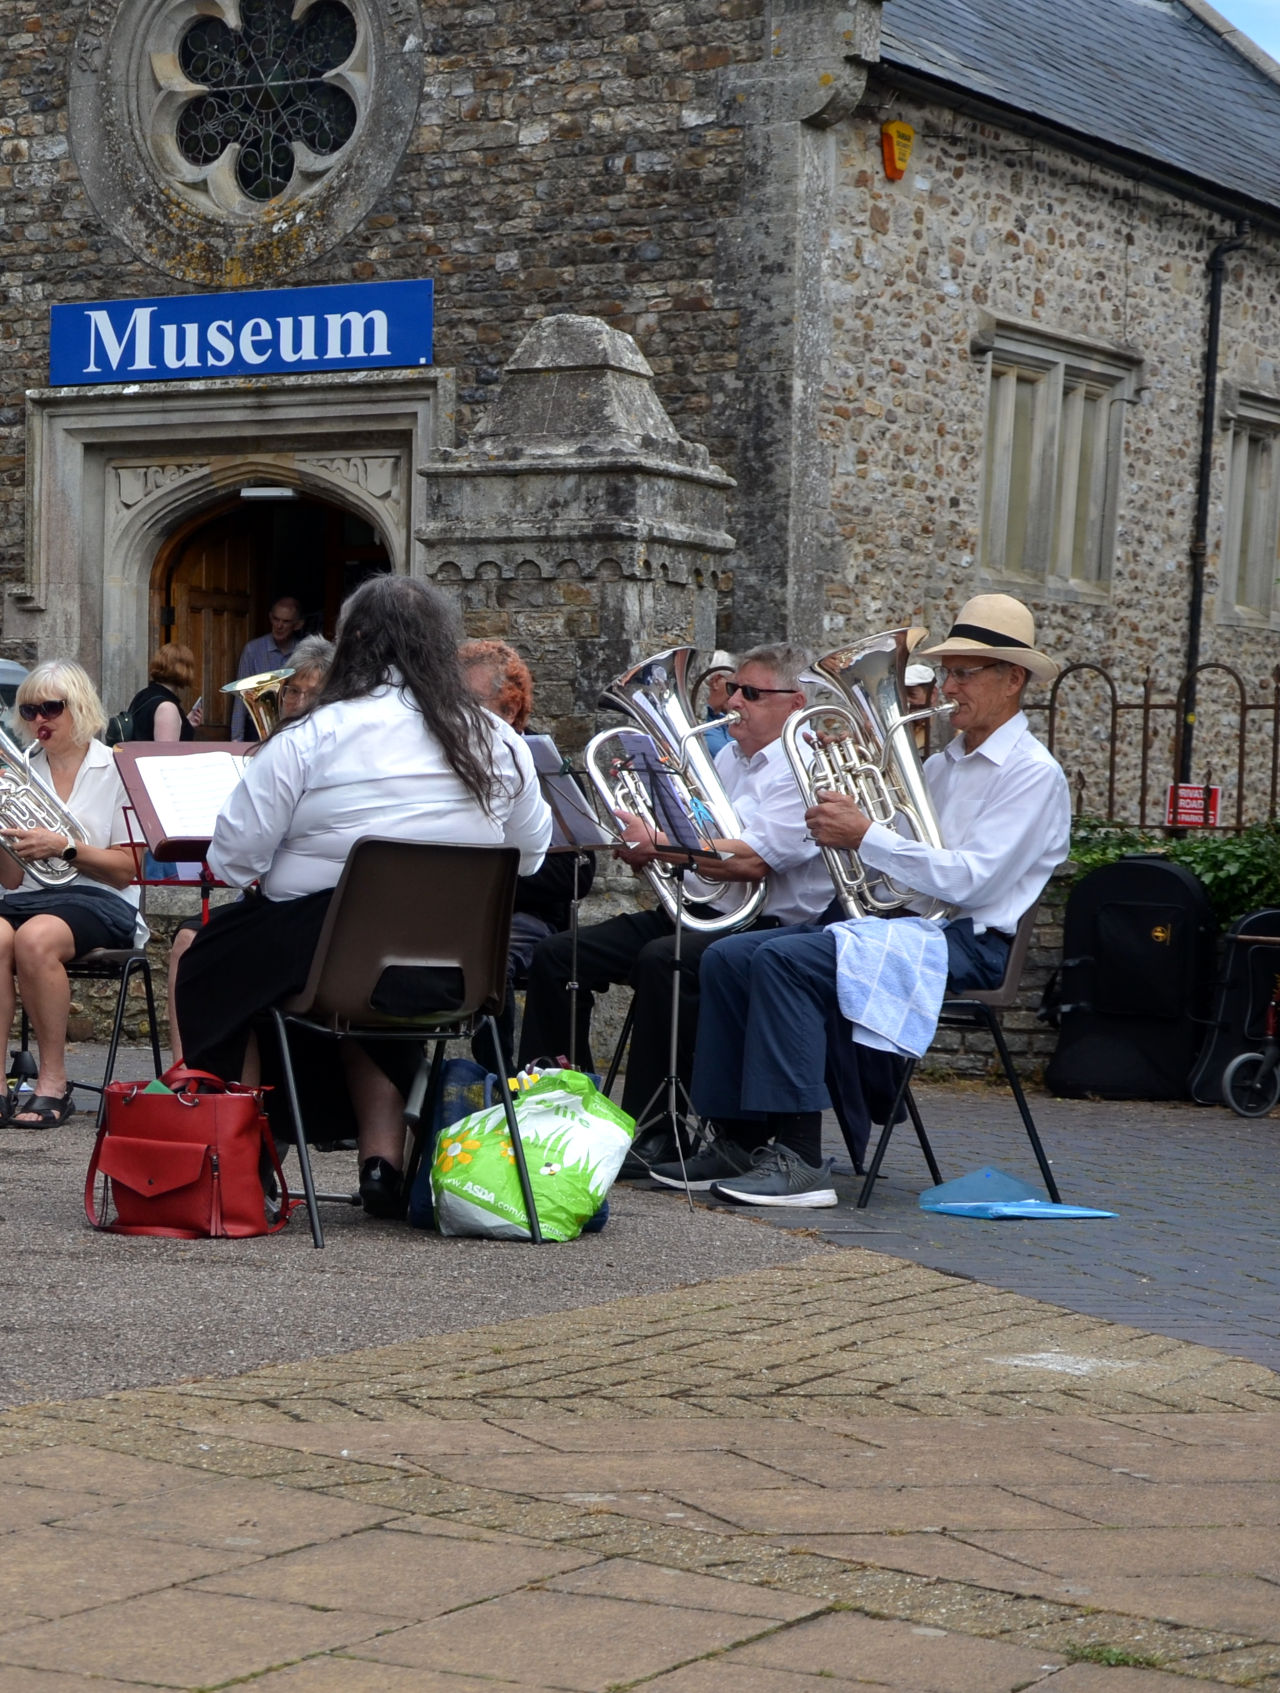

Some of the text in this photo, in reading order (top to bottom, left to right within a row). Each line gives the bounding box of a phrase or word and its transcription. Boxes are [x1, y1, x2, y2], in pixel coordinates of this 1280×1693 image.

[83, 307, 391, 372] Museum
[1178, 799, 1205, 809] ROAD
[1181, 814, 1216, 824] PARKIG
[462, 1181, 496, 1204] ASDA
